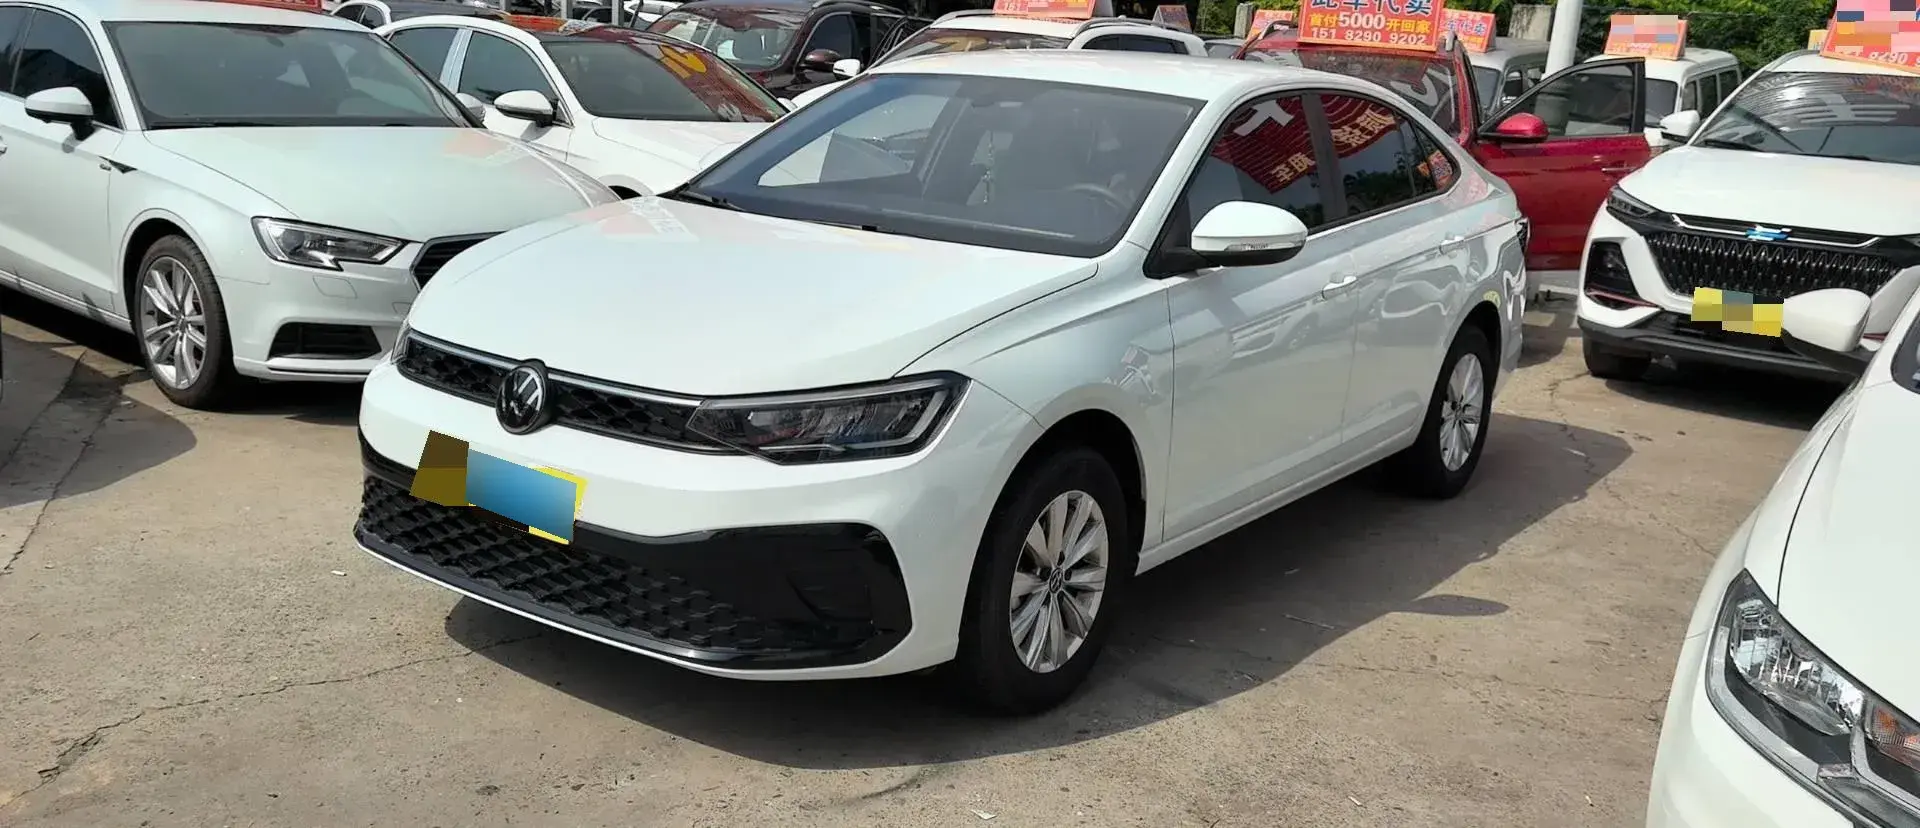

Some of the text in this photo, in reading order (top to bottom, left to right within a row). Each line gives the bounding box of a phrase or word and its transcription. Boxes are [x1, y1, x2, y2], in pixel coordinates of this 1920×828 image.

[1310, 12, 1431, 33] 首付5000开回家
[1311, 27, 1427, 46] 151 8290 9202
